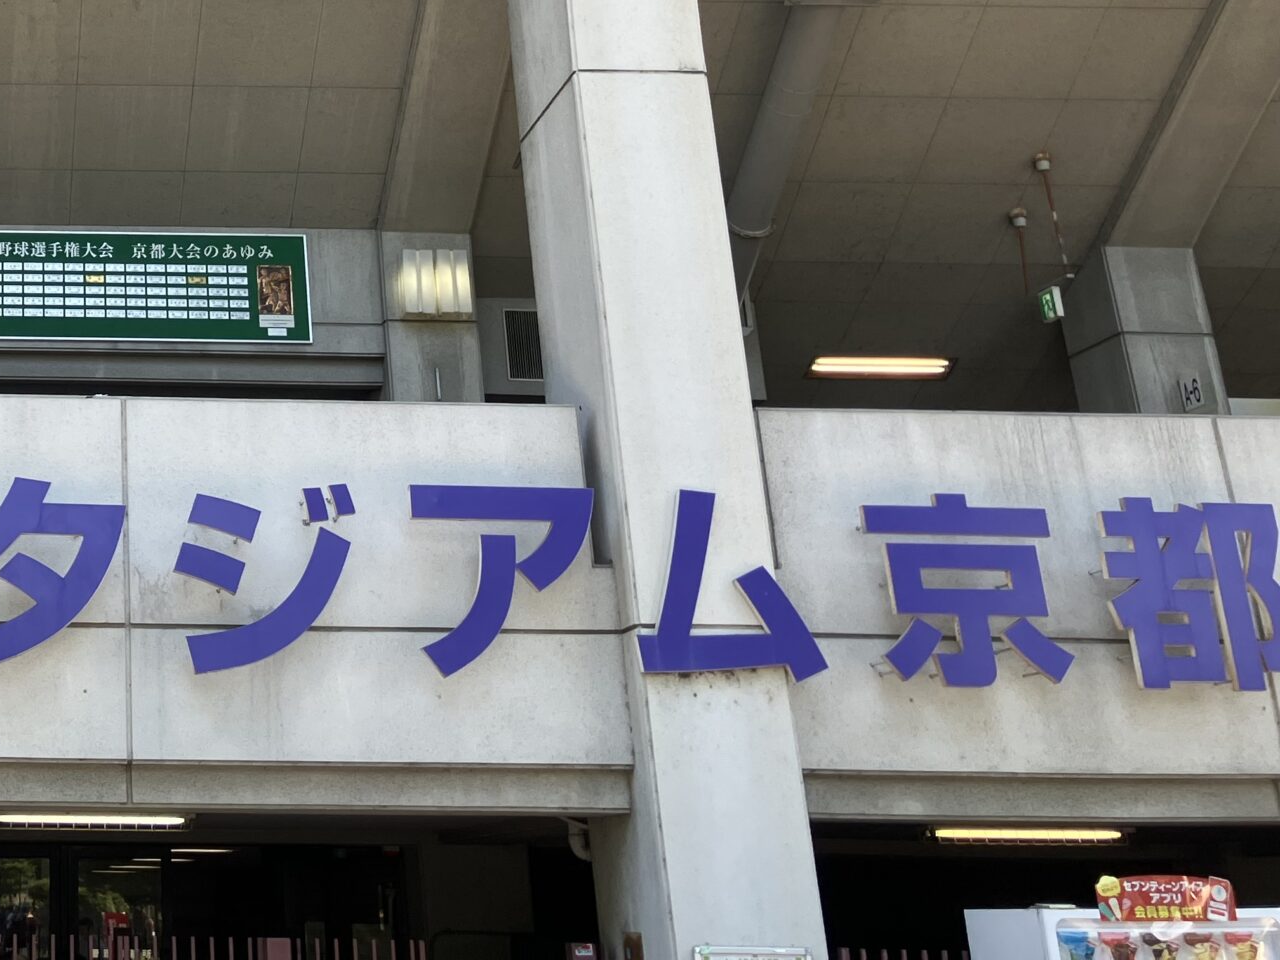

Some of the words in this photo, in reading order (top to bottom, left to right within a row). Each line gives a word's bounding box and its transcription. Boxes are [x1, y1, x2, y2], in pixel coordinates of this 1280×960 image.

[131, 243, 275, 261] 京都大会のあゆみ
[1183, 378, 1201, 408] A-6
[1149, 893, 1182, 904] アプリ
